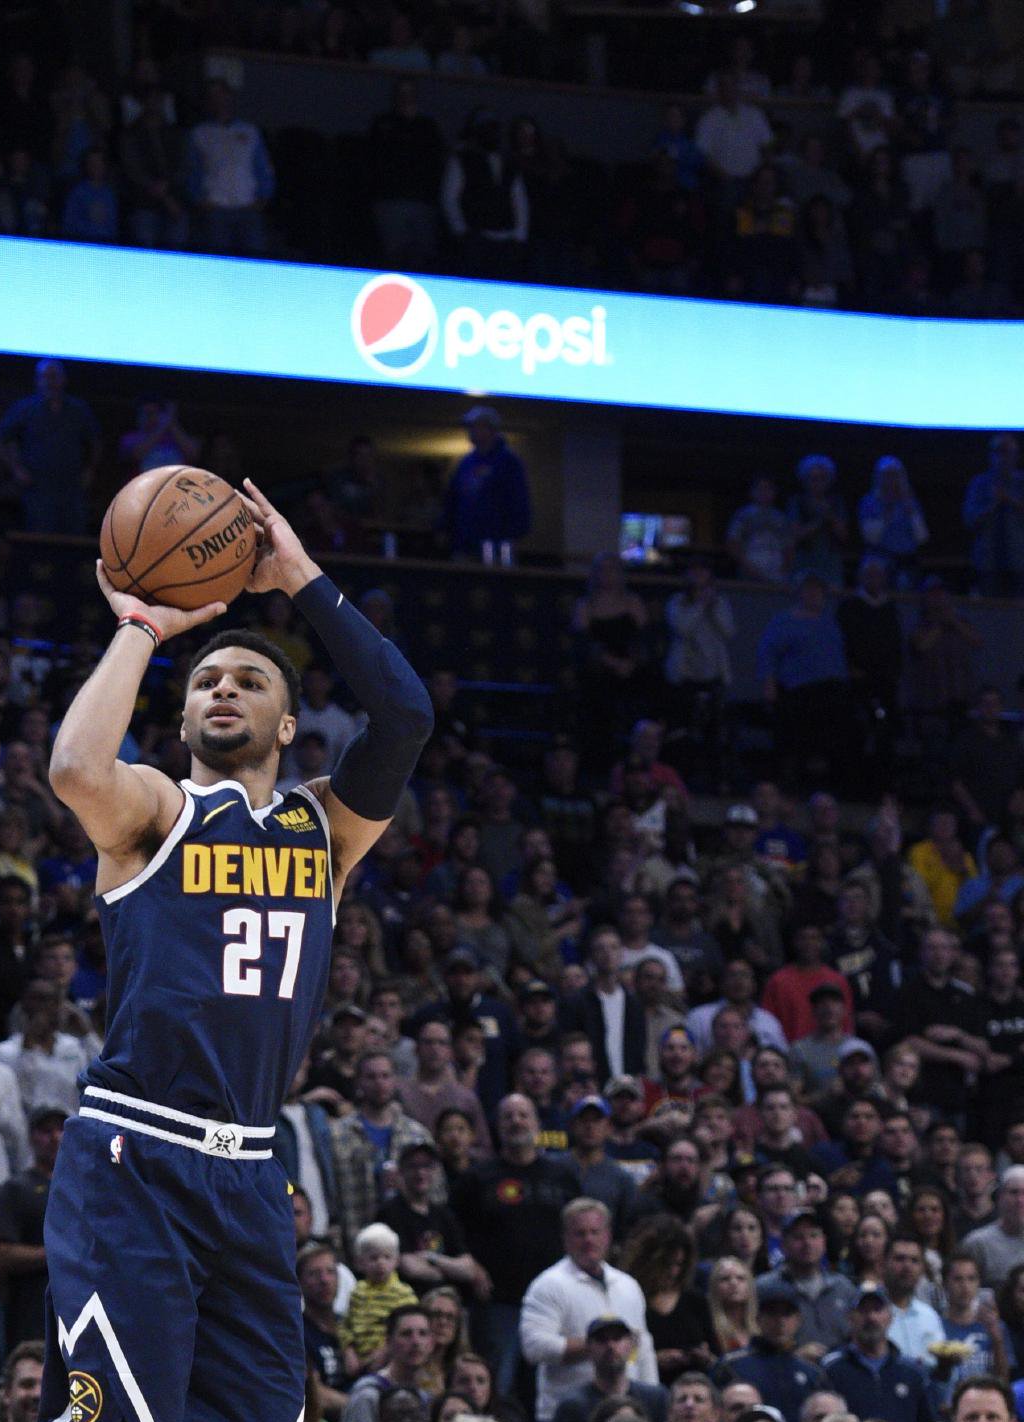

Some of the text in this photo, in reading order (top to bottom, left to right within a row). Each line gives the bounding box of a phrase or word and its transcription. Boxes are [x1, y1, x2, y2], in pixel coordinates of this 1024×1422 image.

[443, 304, 608, 376] pepsi
[182, 500, 252, 569] PALDING
[182, 843, 327, 899] DENVER
[222, 907, 306, 999] 27
